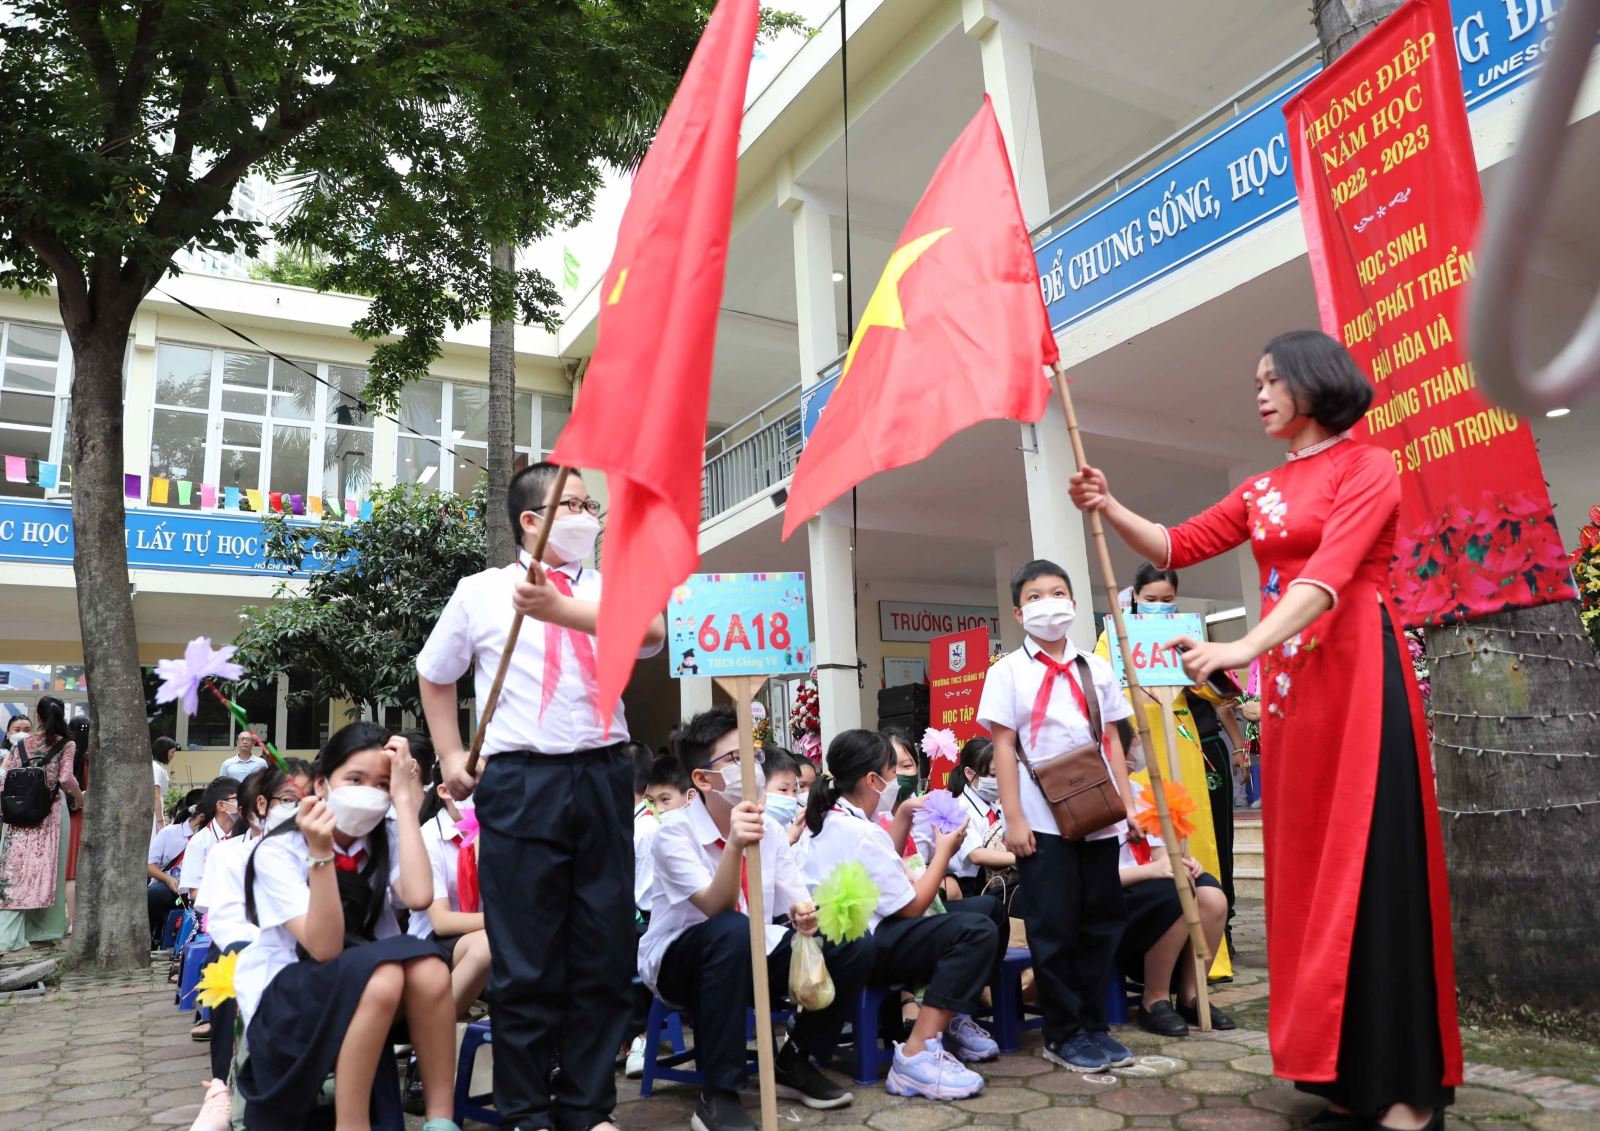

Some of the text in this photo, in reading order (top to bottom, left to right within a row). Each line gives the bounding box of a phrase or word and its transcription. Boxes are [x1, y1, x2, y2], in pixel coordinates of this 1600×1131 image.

[1477, 36, 1554, 88] UNESC
[1305, 32, 1436, 149] THÔNG ĐIỆP
[1321, 84, 1423, 175] NĂM HỌC
[1331, 167, 1369, 211] 2022
[1381, 124, 1430, 174] 2023
[1068, 218, 1144, 291] CHUNG
[1148, 177, 1221, 247] SỐNG,
[1227, 132, 1289, 202] HỌC
[1356, 223, 1429, 288] HỌC SINH
[1343, 245, 1477, 348] ĐƯỢC PHÁT TRIỂN
[1392, 331, 1427, 369] HÒA
[1426, 313, 1453, 350] VÀ
[1364, 386, 1421, 436] TRƯỞNG
[1421, 426, 1455, 463] TÔN
[1455, 405, 1519, 450] TRỌNG
[21, 521, 69, 547] HỌC
[136, 521, 175, 551] LẤY
[182, 530, 211, 557] TỰ
[217, 535, 258, 559] HỌC
[698, 612, 791, 652] 6A18
[890, 609, 953, 633] TRƯỜNG
[1131, 641, 1179, 669] 6A1
[942, 705, 975, 726] HỌC TẬP
